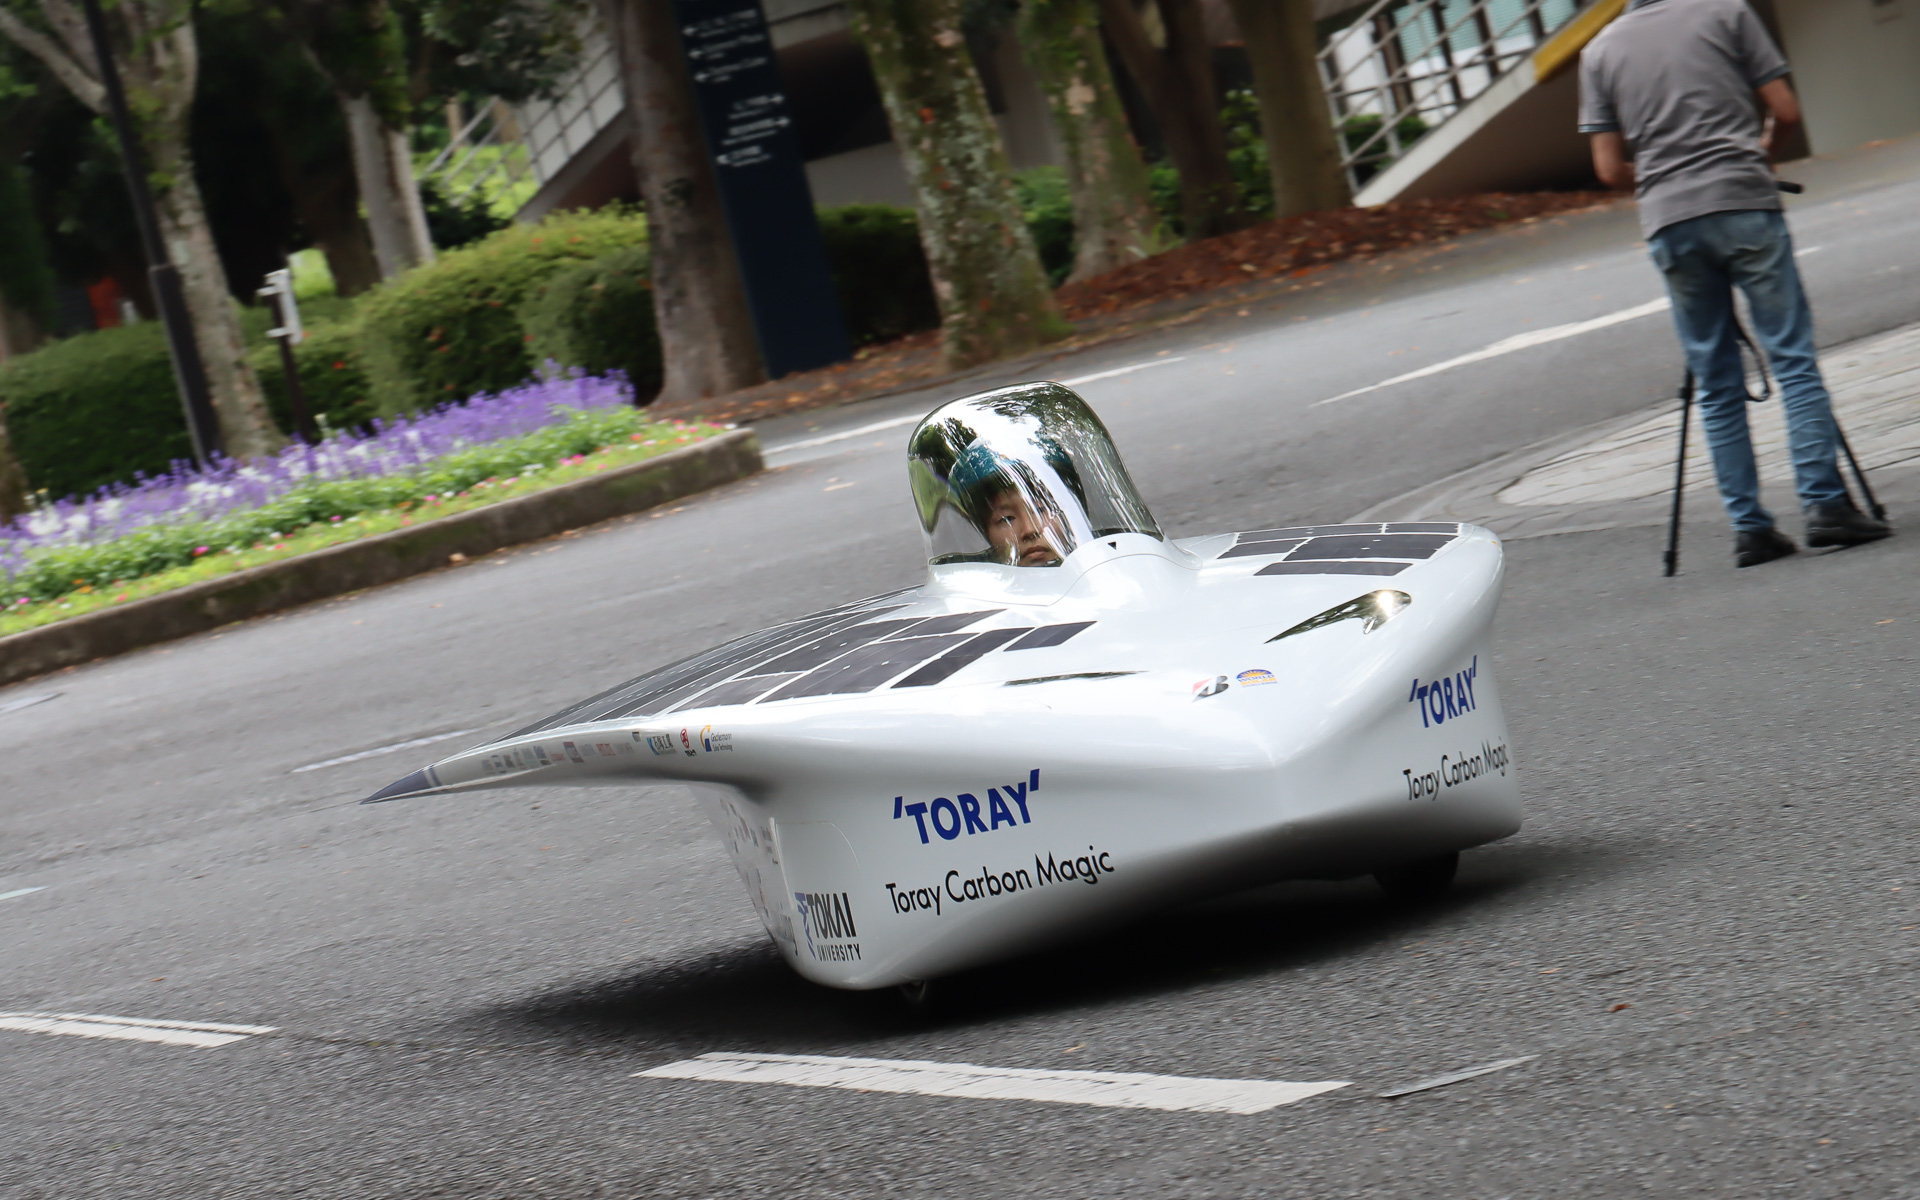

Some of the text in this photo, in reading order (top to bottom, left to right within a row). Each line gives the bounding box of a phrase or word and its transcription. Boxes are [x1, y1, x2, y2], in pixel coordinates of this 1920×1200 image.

[1402, 768, 1440, 801] Toray
[1441, 751, 1484, 788] Carbon
[885, 845, 1115, 916] Toray Carbon Magic
[806, 892, 857, 939] TOKAI
[817, 943, 862, 962] UNIVERSITY
